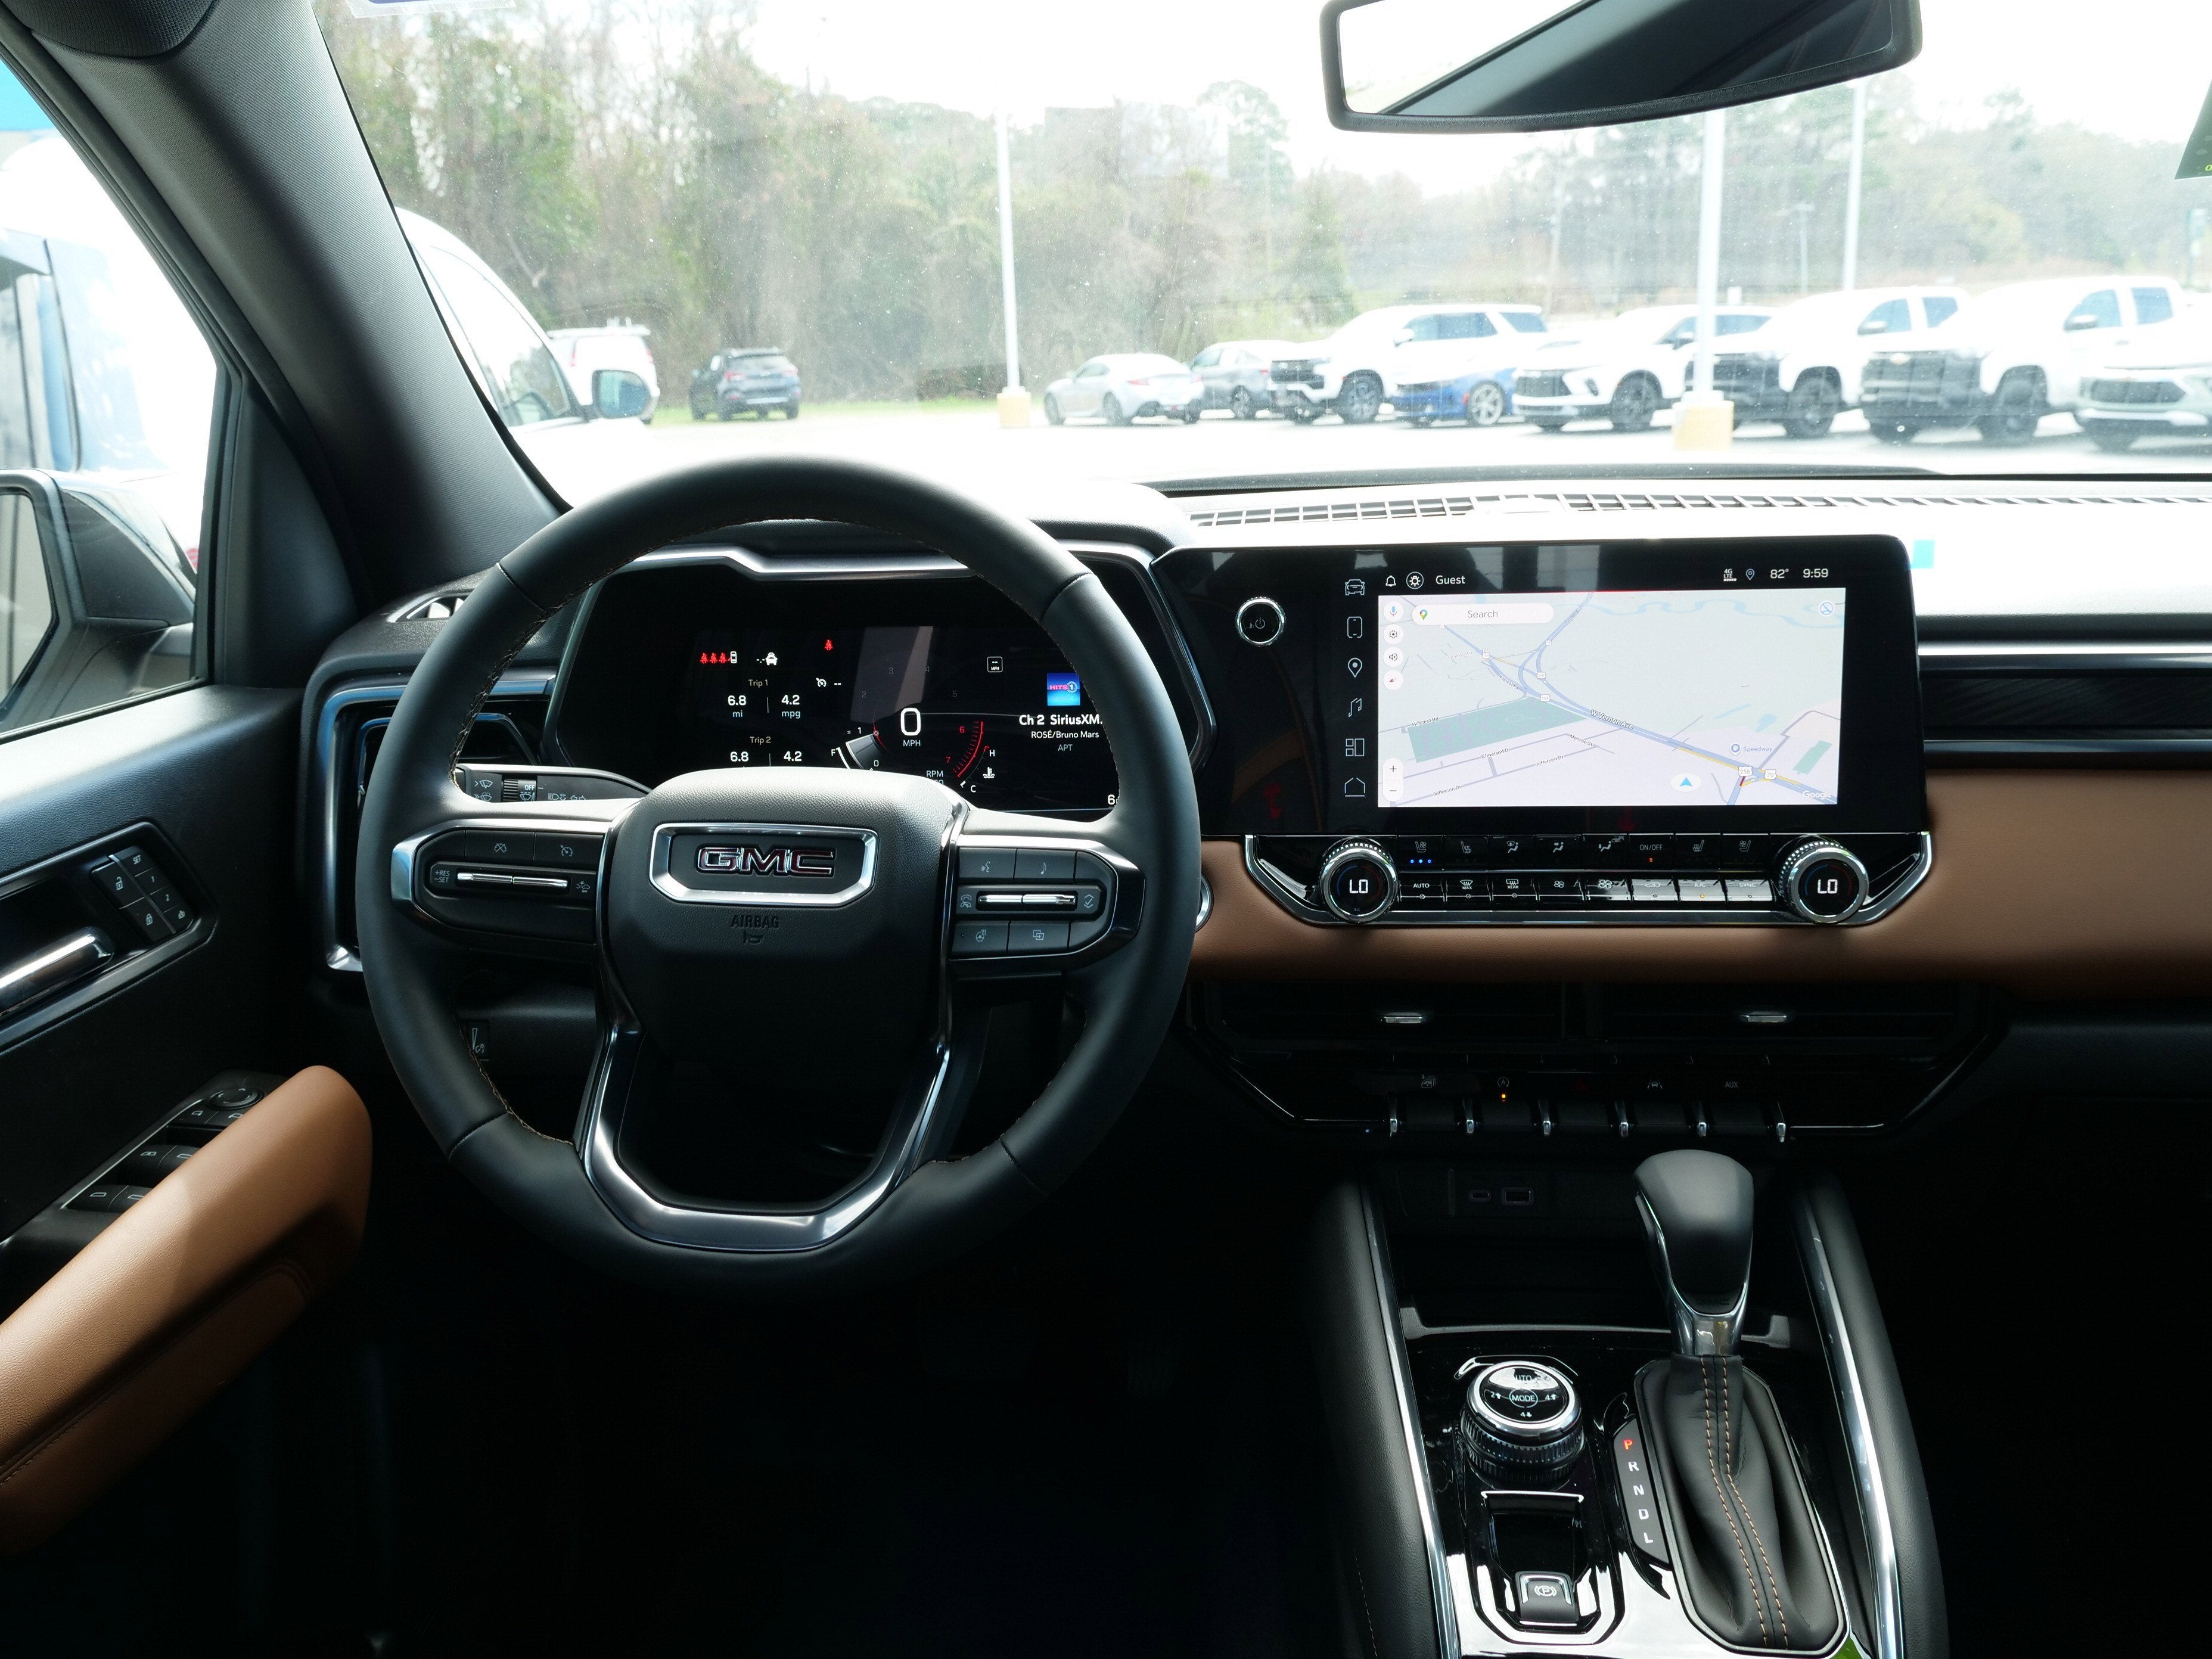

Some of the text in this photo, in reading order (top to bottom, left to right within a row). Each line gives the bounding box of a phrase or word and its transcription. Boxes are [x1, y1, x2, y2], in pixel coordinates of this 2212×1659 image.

[1770, 568, 1789, 579] 82°
[1803, 568, 1829, 578] 9:59
[1436, 574, 1465, 585] Guest
[1467, 610, 1498, 619] Search
[748, 679, 763, 688] Trip
[728, 695, 746, 706] 6.8
[781, 694, 800, 706] 4.2
[781, 710, 801, 719] mpg
[1019, 714, 1034, 725] Ch
[1037, 714, 1045, 725] 2
[900, 707, 921, 736] 0
[1412, 717, 1431, 727] Hillcrest
[1598, 712, 1620, 726] Vernon
[1620, 719, 1634, 730] Ave
[1031, 729, 1079, 738] ROSÉ/Bruno
[1569, 734, 1587, 744] Monroe
[750, 736, 765, 745] Trip
[730, 751, 749, 762] 6.8
[783, 751, 802, 762] 4.2
[1481, 749, 1505, 759] Cleveland
[1535, 757, 1558, 766] Jefferson
[1433, 787, 1455, 796] Jefferson
[1802, 790, 1832, 800] Google
[132, 855, 141, 865] SET
[697, 846, 834, 874] GMC
[1349, 878, 1369, 894] LO
[1817, 878, 1838, 894] LO
[731, 915, 779, 930] AIRBAG
[1623, 1439, 1633, 1449] P
[1627, 1461, 1639, 1471] R
[1633, 1484, 1645, 1495] N
[1638, 1509, 1649, 1520] D
[1644, 1532, 1654, 1543] L
